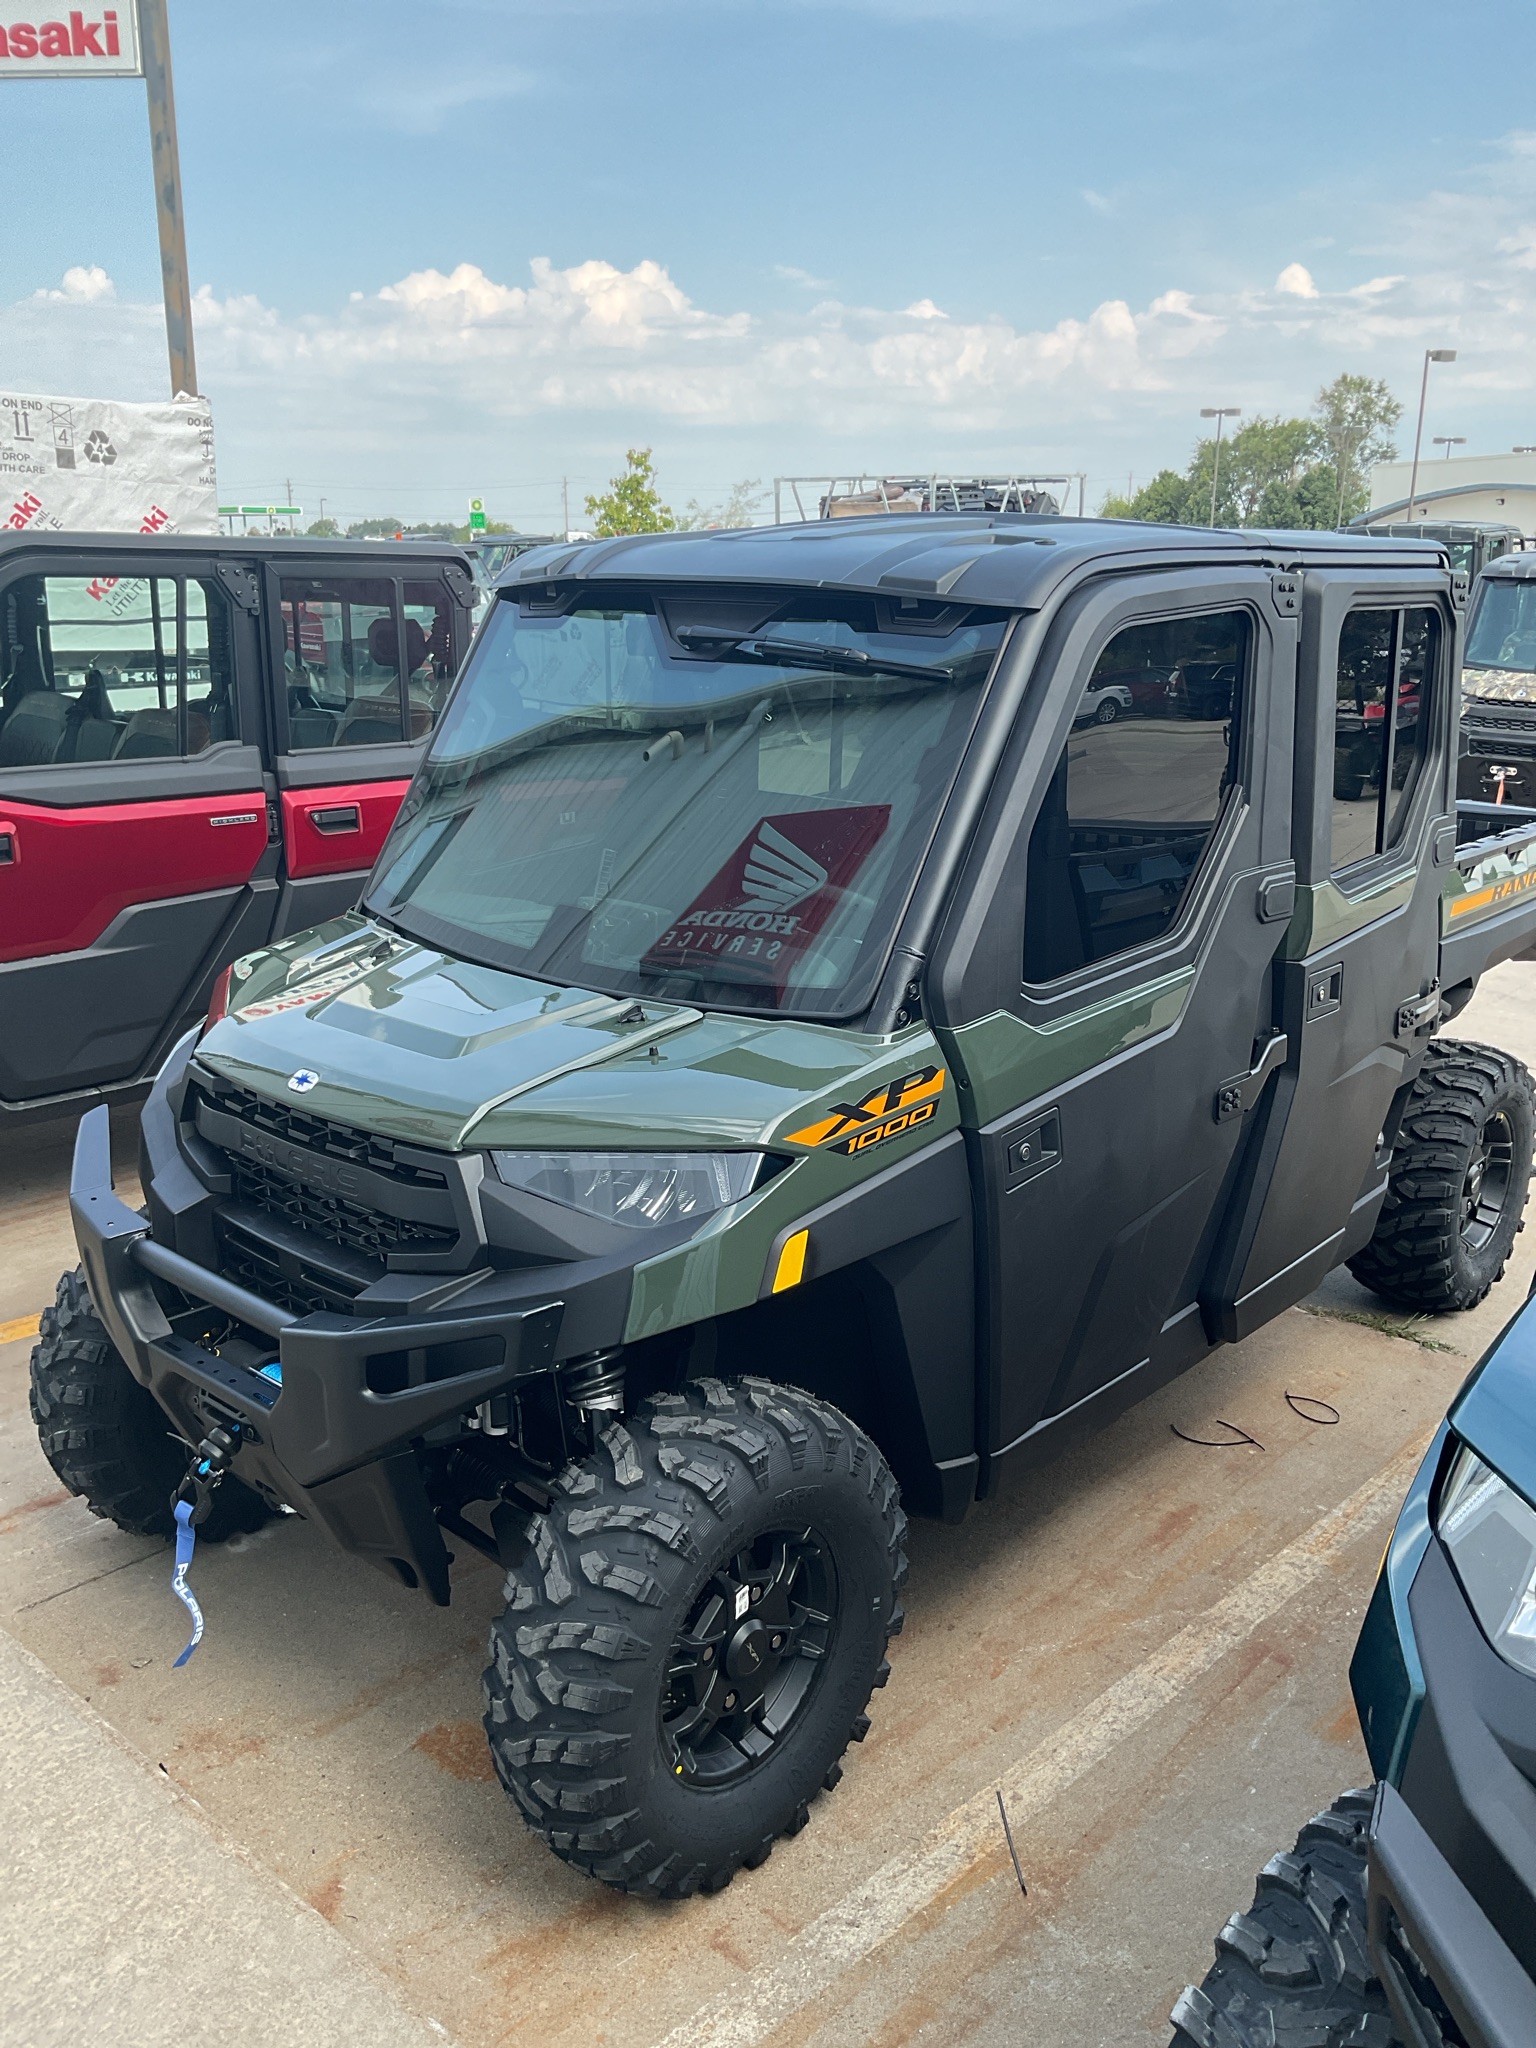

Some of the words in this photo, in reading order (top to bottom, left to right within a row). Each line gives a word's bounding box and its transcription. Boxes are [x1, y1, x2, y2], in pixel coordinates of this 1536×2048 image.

[2, 398, 18, 409] ON
[20, 400, 43, 411] END
[187, 417, 201, 427] DO
[58, 428, 69, 445] 4
[2, 451, 31, 462] DROP
[96, 443, 105, 454] 4
[18, 464, 46, 474] CARE
[111, 577, 149, 617] UTILITY
[817, 1064, 939, 1143] XP
[847, 1102, 934, 1154] 1000
[174, 1562, 204, 1647] POLARIS
[744, 1641, 760, 1662] XP
